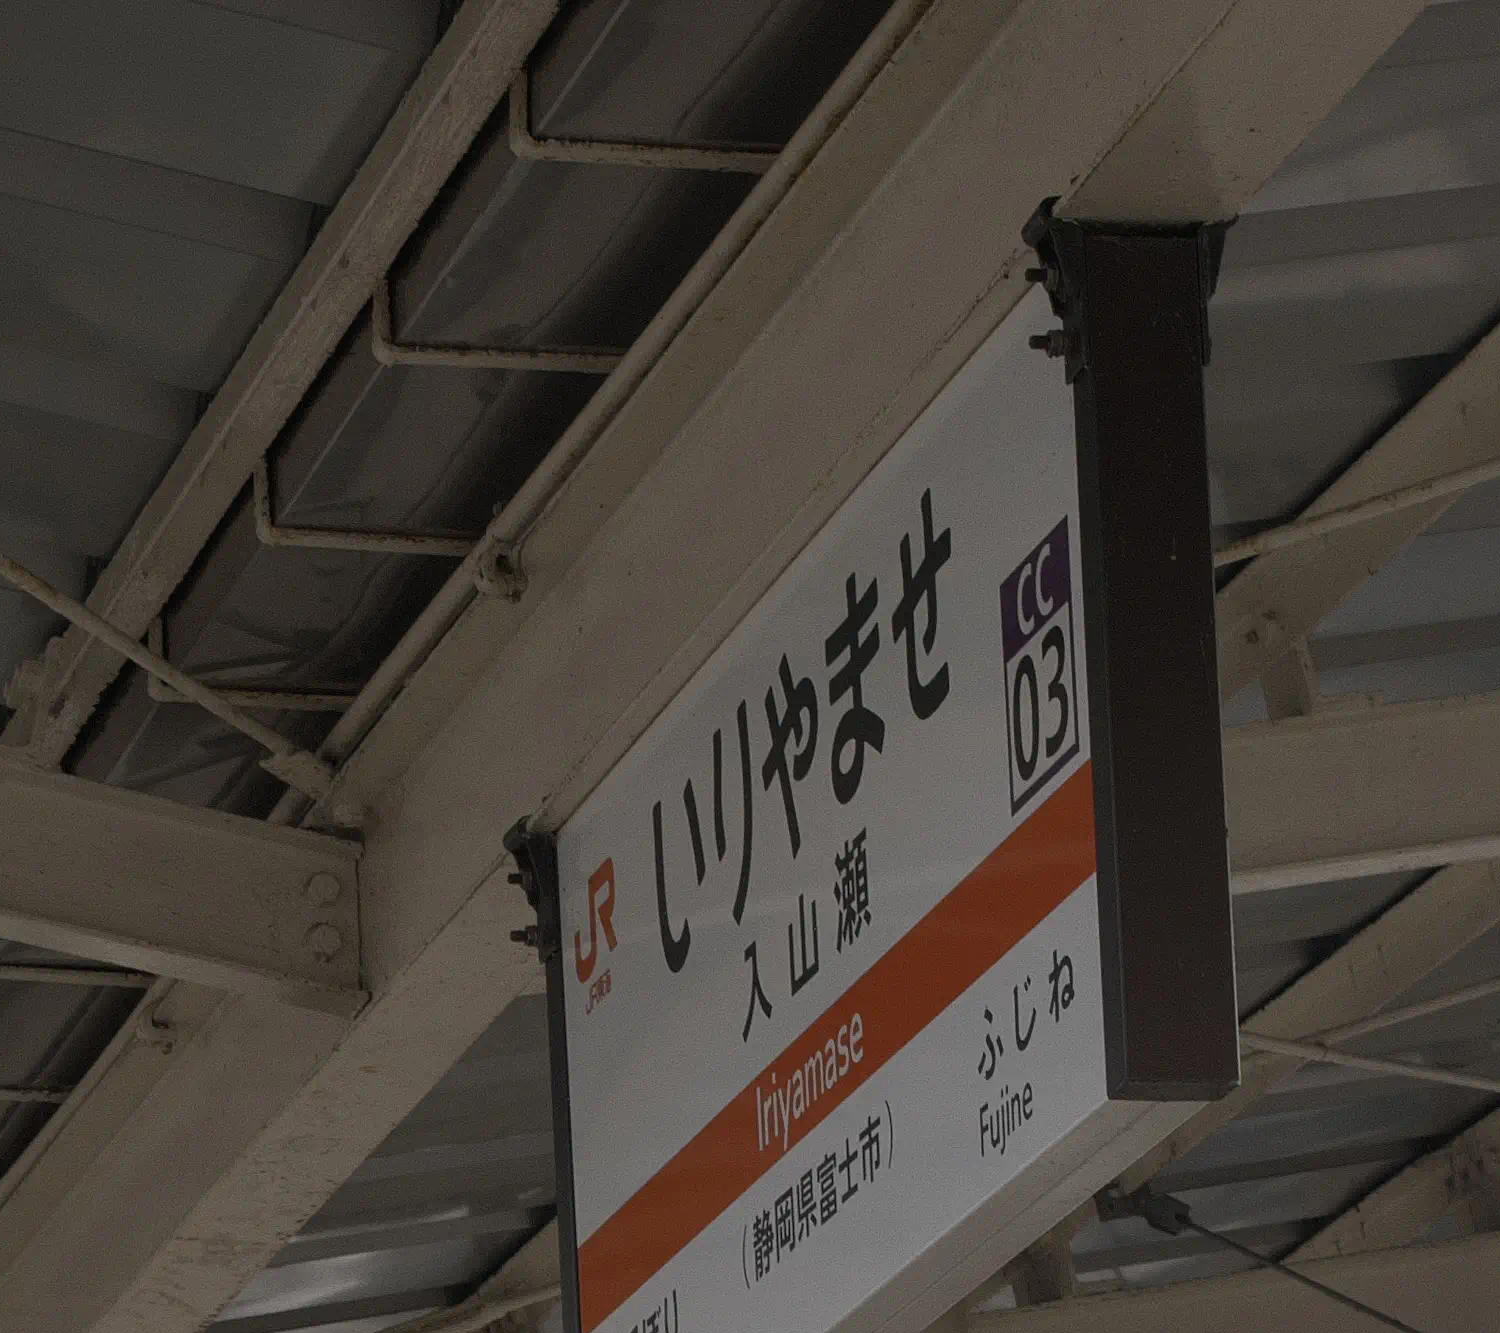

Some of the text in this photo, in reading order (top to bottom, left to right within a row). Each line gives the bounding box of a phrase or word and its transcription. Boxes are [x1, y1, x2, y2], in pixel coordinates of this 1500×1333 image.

[1016, 543, 1054, 636] CC
[653, 487, 952, 973] いりやませ
[1013, 625, 1069, 781] 03
[574, 857, 618, 984] JR
[741, 826, 872, 1044] 入山瀬
[755, 1012, 864, 1152] Iriyamase
[977, 949, 1075, 1081] ふじね
[979, 1081, 1034, 1158] Fujine
[741, 1099, 894, 1291] （静岡県富士市）
